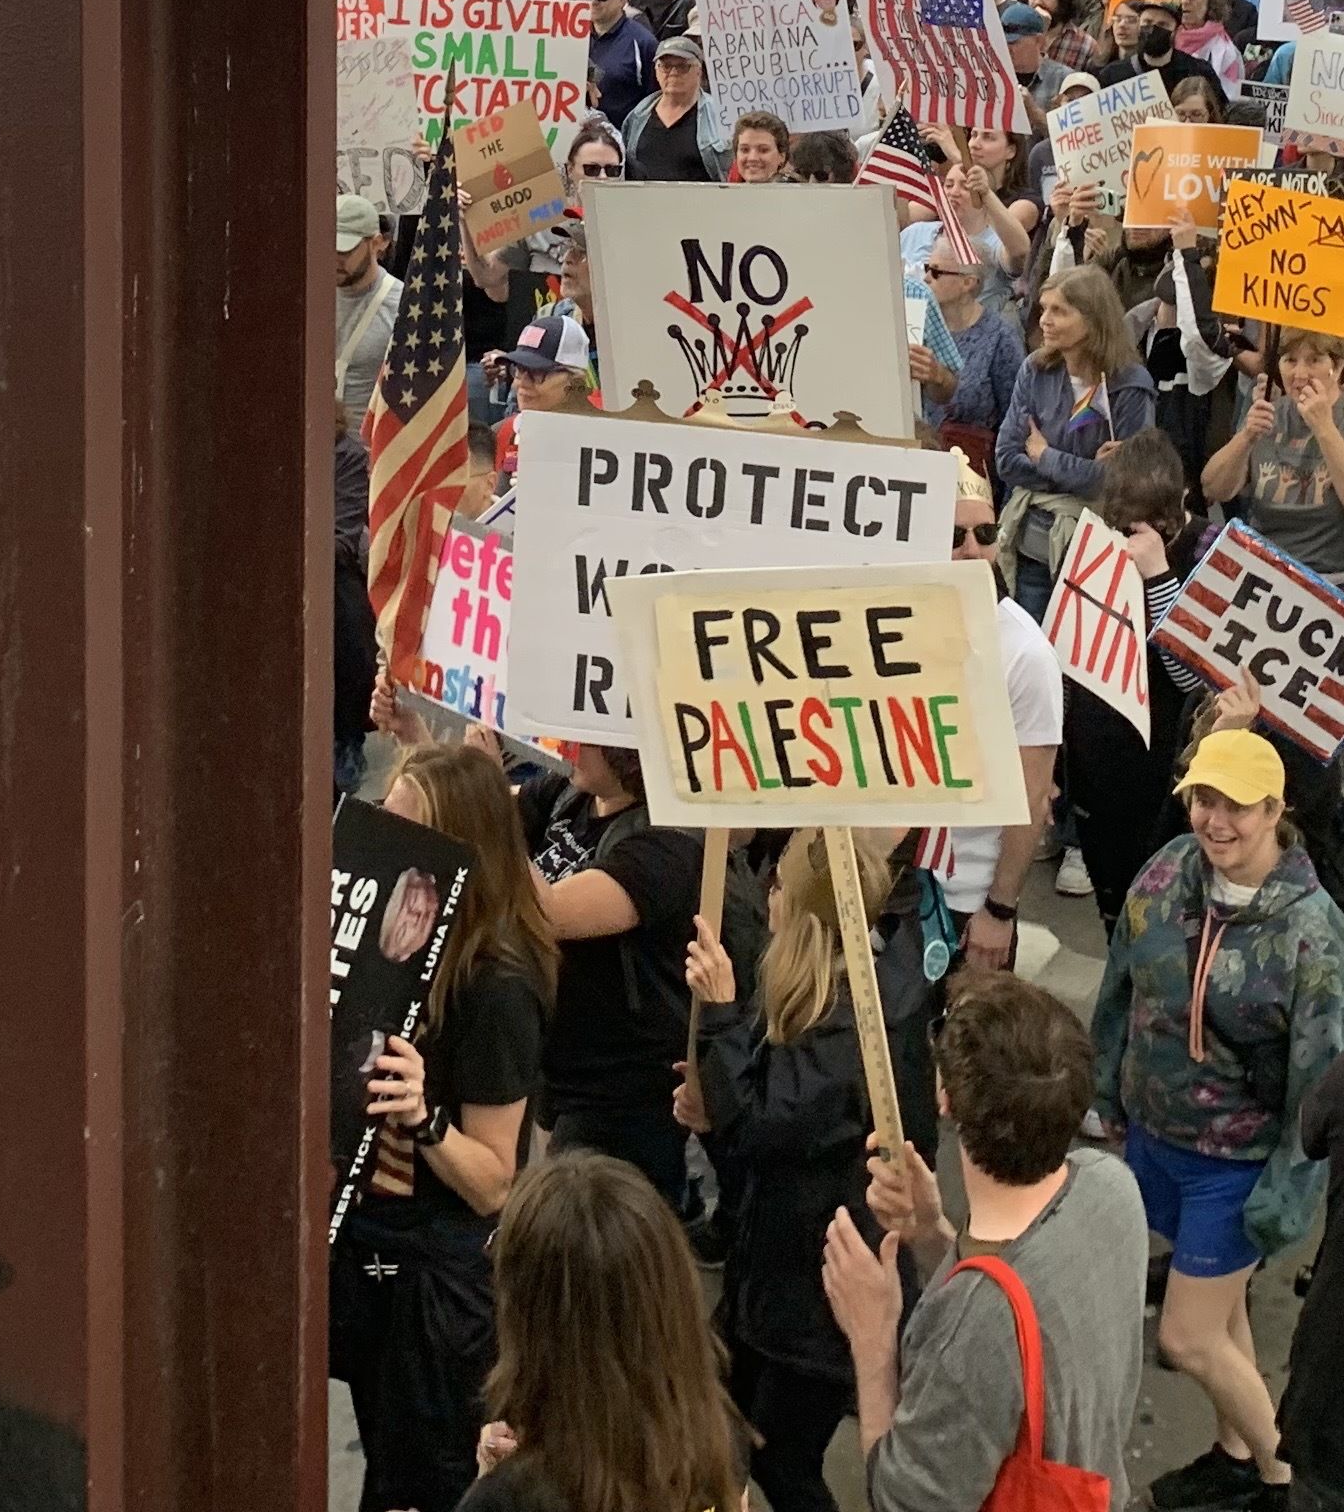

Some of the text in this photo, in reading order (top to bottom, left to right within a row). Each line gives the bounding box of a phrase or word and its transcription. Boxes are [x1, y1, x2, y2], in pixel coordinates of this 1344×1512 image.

[707, 1, 815, 34] AMERICA
[411, 31, 558, 81] SMALL
[708, 25, 819, 58] A BANANA
[800, 94, 861, 123] RULED
[1056, 76, 1156, 132] WE HAVE
[465, 115, 505, 145] FED
[1056, 122, 1104, 154] THREE
[478, 138, 505, 161] THE
[1167, 153, 1257, 170] SIDE WITH
[490, 187, 533, 215] BLOOD
[1280, 172, 1305, 193] NOT
[1305, 171, 1330, 199] OK
[528, 197, 566, 223] MEN
[1227, 188, 1266, 226] HEY
[680, 237, 789, 305] NO
[1269, 248, 1306, 276] NO
[1242, 271, 1332, 317] KINGS
[577, 444, 928, 543] PROTECT
[691, 604, 923, 685] FREE
[1211, 618, 1319, 710] ICE
[672, 694, 974, 794] PALESTINE
[420, 866, 469, 981] LUNA TICK
[349, 1125, 377, 1182] TICK
